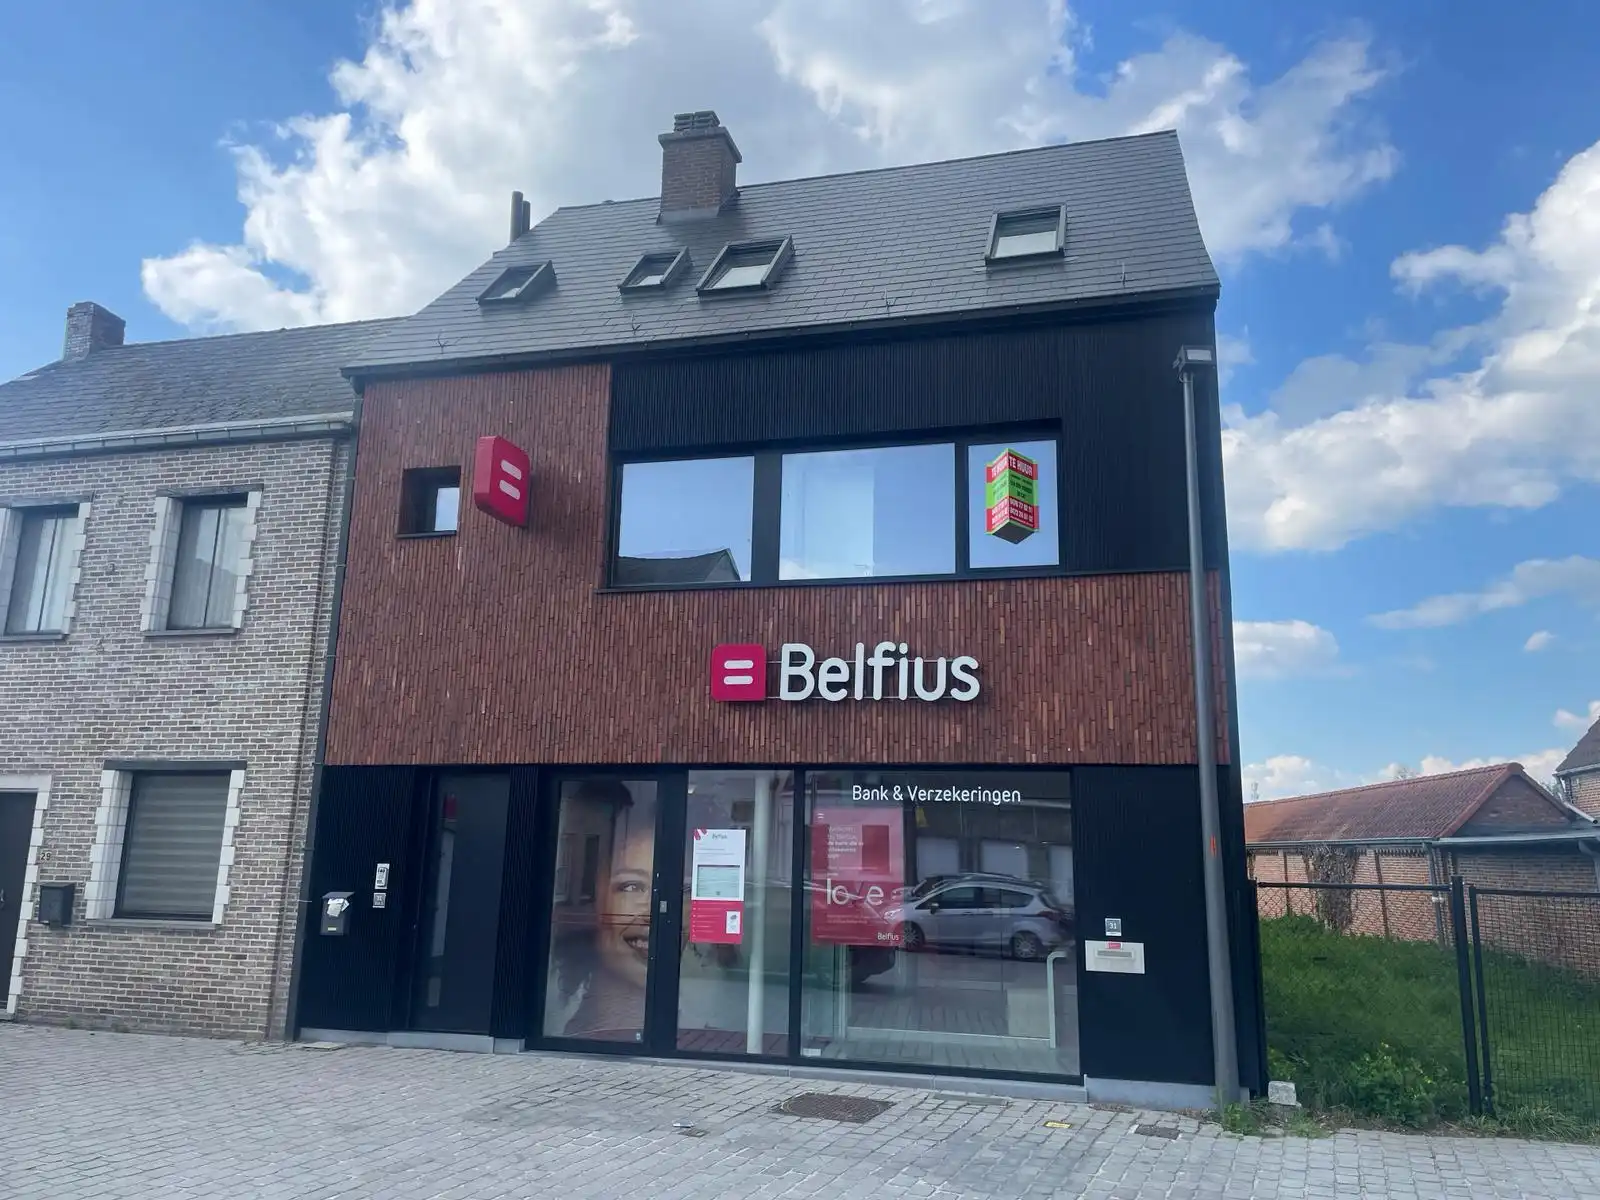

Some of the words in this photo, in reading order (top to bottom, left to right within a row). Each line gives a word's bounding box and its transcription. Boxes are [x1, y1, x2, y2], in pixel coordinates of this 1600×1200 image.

[1009, 455, 1017, 469] TE
[779, 641, 981, 702] Belfius
[852, 785, 889, 801] Bank
[892, 786, 904, 801] &
[907, 785, 1021, 806] Verzekeringen
[40, 852, 51, 861] 29
[826, 877, 885, 906] loe
[1109, 922, 1117, 930] 31
[877, 931, 900, 941] Belfius
